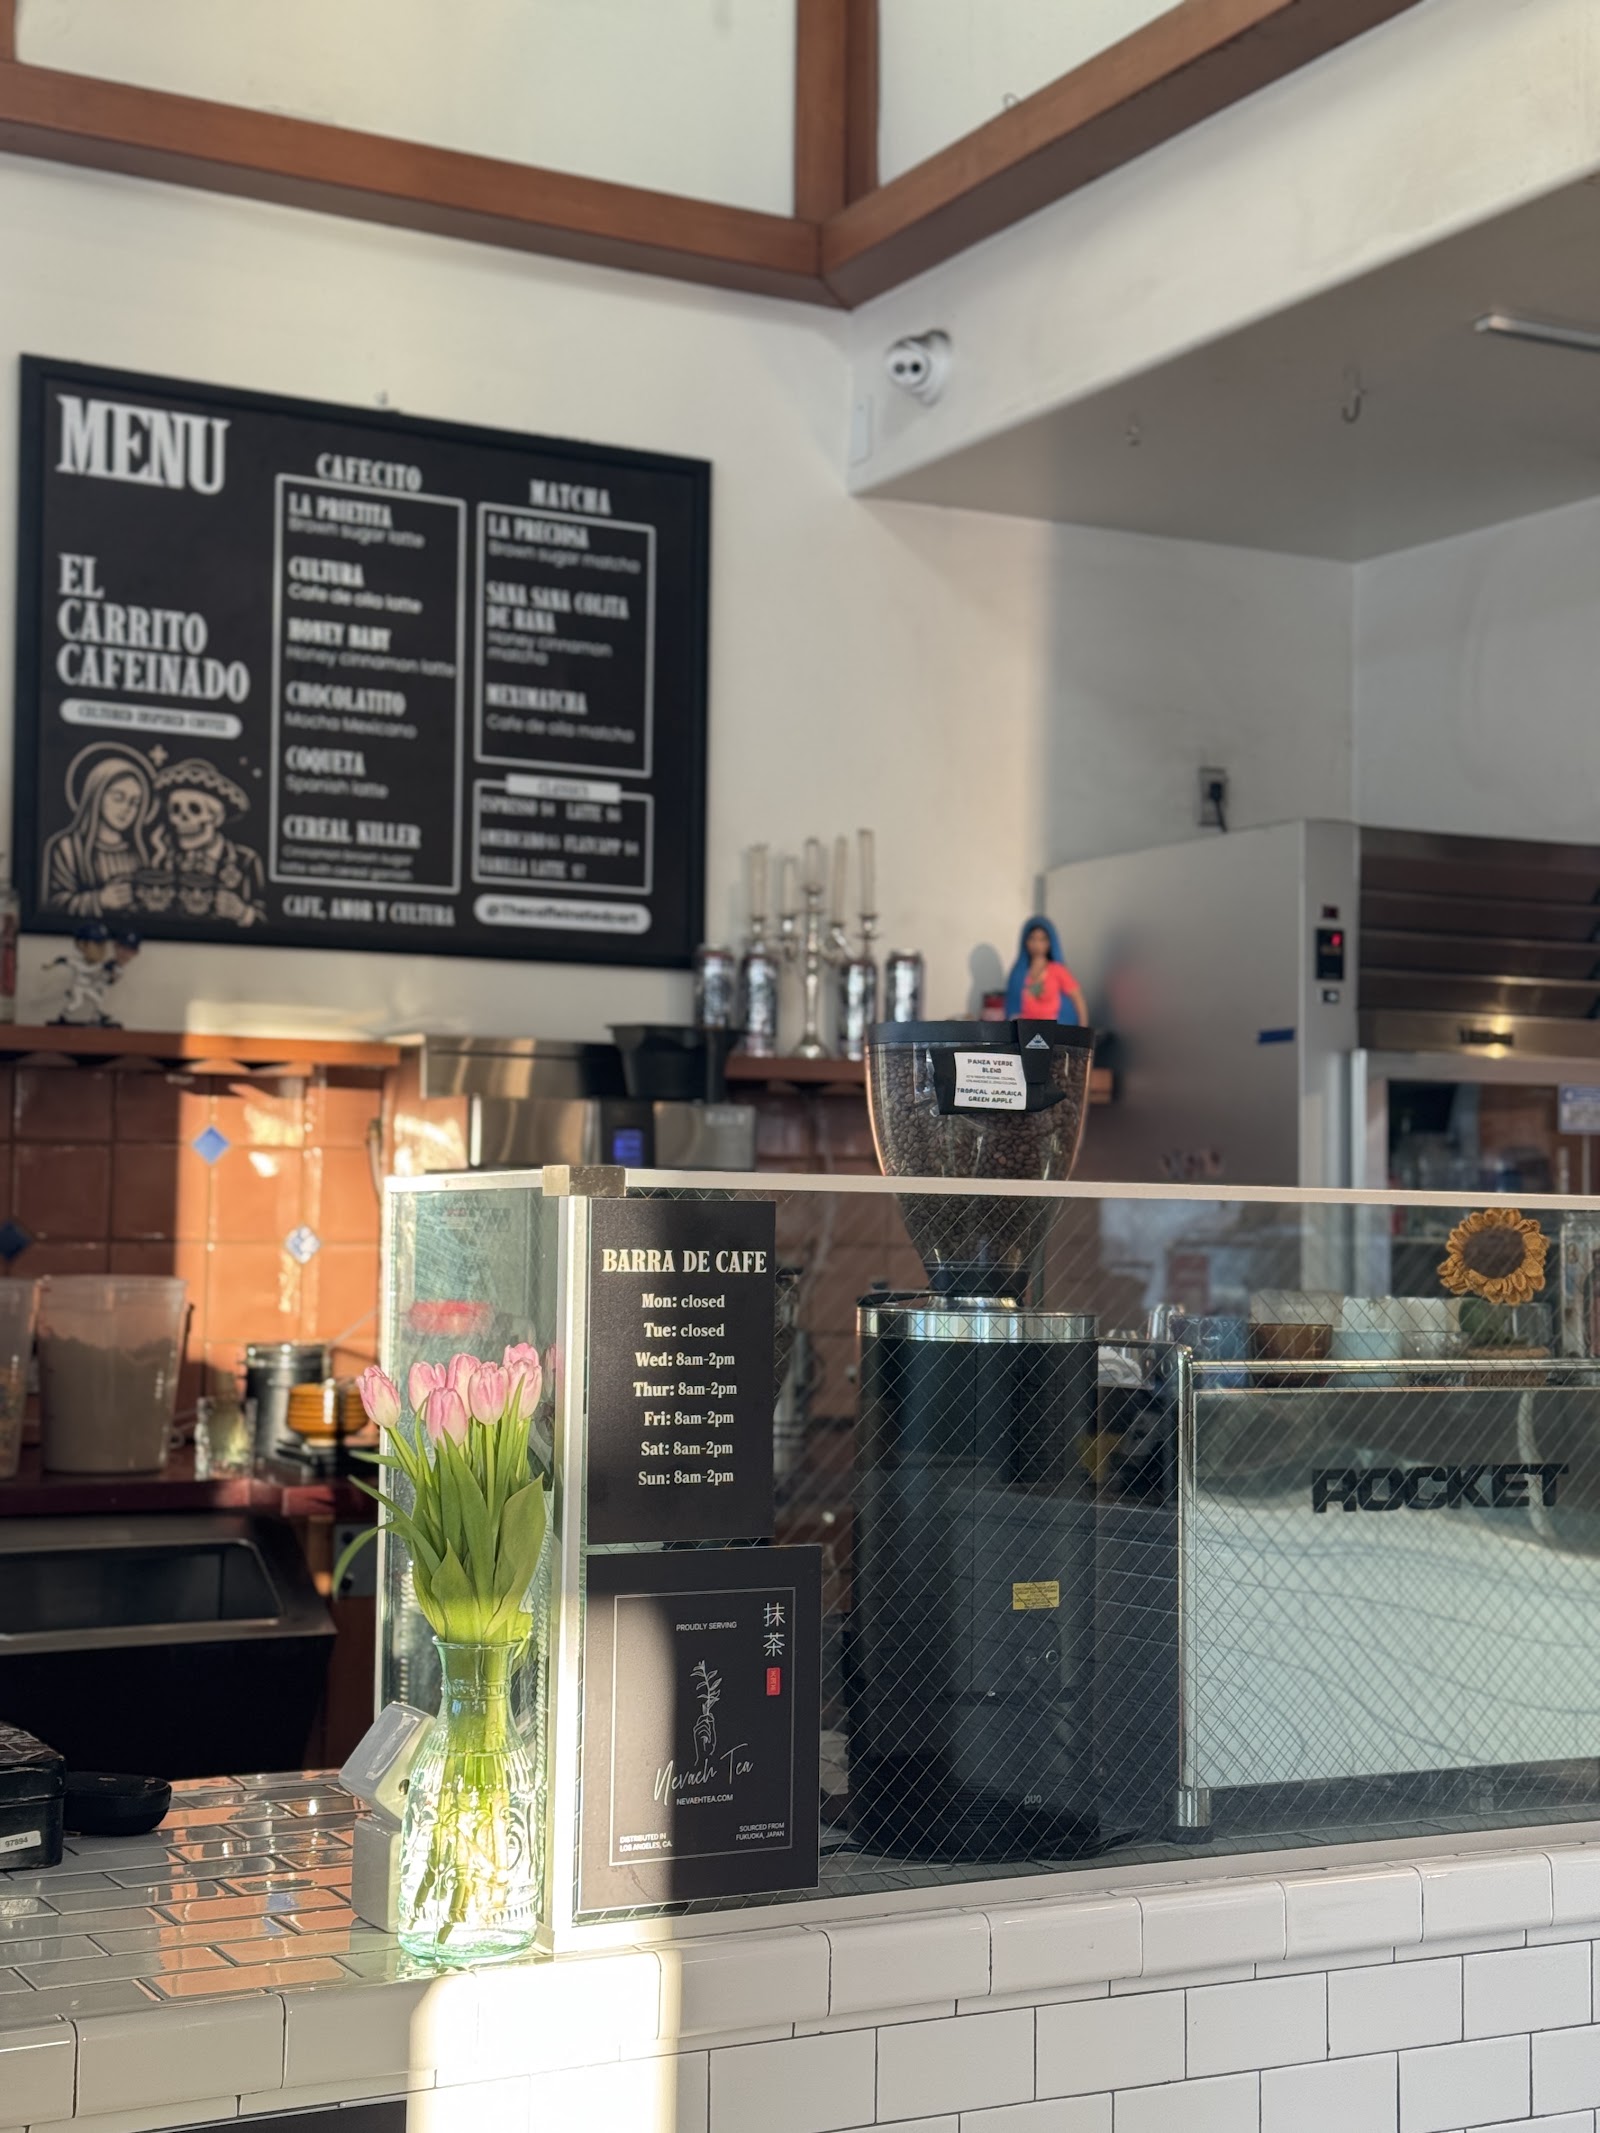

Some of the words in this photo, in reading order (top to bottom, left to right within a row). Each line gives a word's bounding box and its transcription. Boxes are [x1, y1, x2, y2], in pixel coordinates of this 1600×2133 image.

[56, 394, 231, 494] MENU
[316, 452, 422, 491] CAFECITO
[288, 492, 312, 517] LA
[529, 479, 611, 516] MATCHA
[487, 513, 510, 538] LA
[58, 552, 104, 599] EL
[287, 556, 364, 588] CULTURA
[57, 598, 208, 655] CARRITO
[56, 642, 251, 704] CAFEINADO
[285, 745, 366, 777] COQUETA
[283, 814, 352, 843] CEREAL
[356, 819, 421, 849] KILLER
[957, 1087, 987, 1095] TROPICAL
[991, 1089, 1023, 1097] JAMAICA
[602, 1249, 676, 1273] BARRA
[682, 1250, 710, 1273] DE
[715, 1250, 767, 1273] CAFE
[641, 1294, 677, 1308] Mon:
[680, 1294, 725, 1308] closed
[644, 1322, 677, 1337] Tue:
[680, 1323, 725, 1337] closed
[635, 1352, 673, 1367] Wed:
[676, 1352, 735, 1369] 8am-2pm
[633, 1381, 675, 1397] Thur:
[677, 1382, 737, 1399] 8am-2pm
[644, 1411, 671, 1426] Fri:
[674, 1411, 734, 1428] 8am-2pm
[641, 1441, 670, 1456] Sat:
[672, 1441, 733, 1458] 8am-2pm
[638, 1471, 671, 1486] Sun:
[673, 1470, 734, 1487] 8am-2pm
[1312, 1463, 1569, 1513] ROCKET
[676, 1622, 708, 1631] PROUDLY
[708, 1621, 737, 1630] SERVING
[762, 1602, 786, 1657] 抹茶
[654, 1758, 718, 1806] Nevaeh
[720, 1743, 754, 1784] Tea
[676, 1794, 734, 1806] NEVAEHTEA.COM
[619, 1833, 659, 1844] DISTRIBUTED
[660, 1832, 667, 1840] IN
[735, 1832, 765, 1841] FUKUOKA,
[766, 1830, 785, 1839] JAPAN
[739, 1824, 767, 1833] SOURCED
[768, 1822, 785, 1831] FROM
[5, 1836, 28, 1847] 97894
[619, 1844, 632, 1852] LOS
[633, 1842, 662, 1852] ANGELES,
